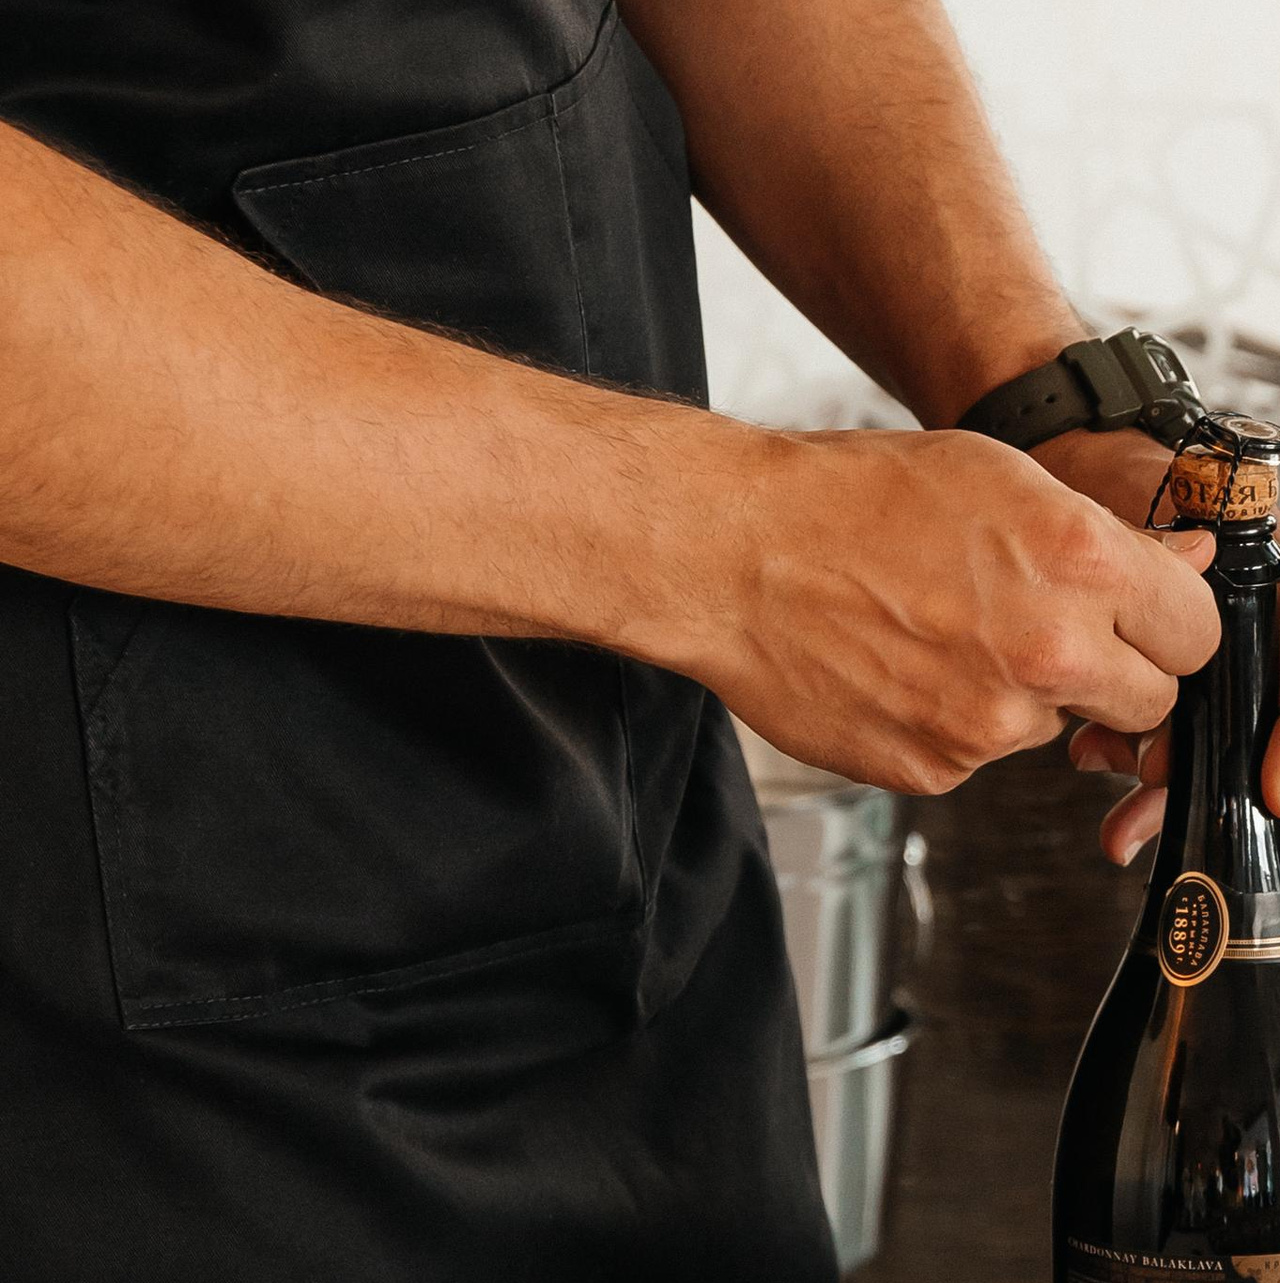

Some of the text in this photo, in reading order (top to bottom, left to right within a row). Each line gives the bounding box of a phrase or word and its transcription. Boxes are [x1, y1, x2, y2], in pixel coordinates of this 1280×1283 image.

[1169, 907, 1189, 954] 1889
[1067, 1235, 1224, 1271] CHARDONNAY BALAKLAVA
